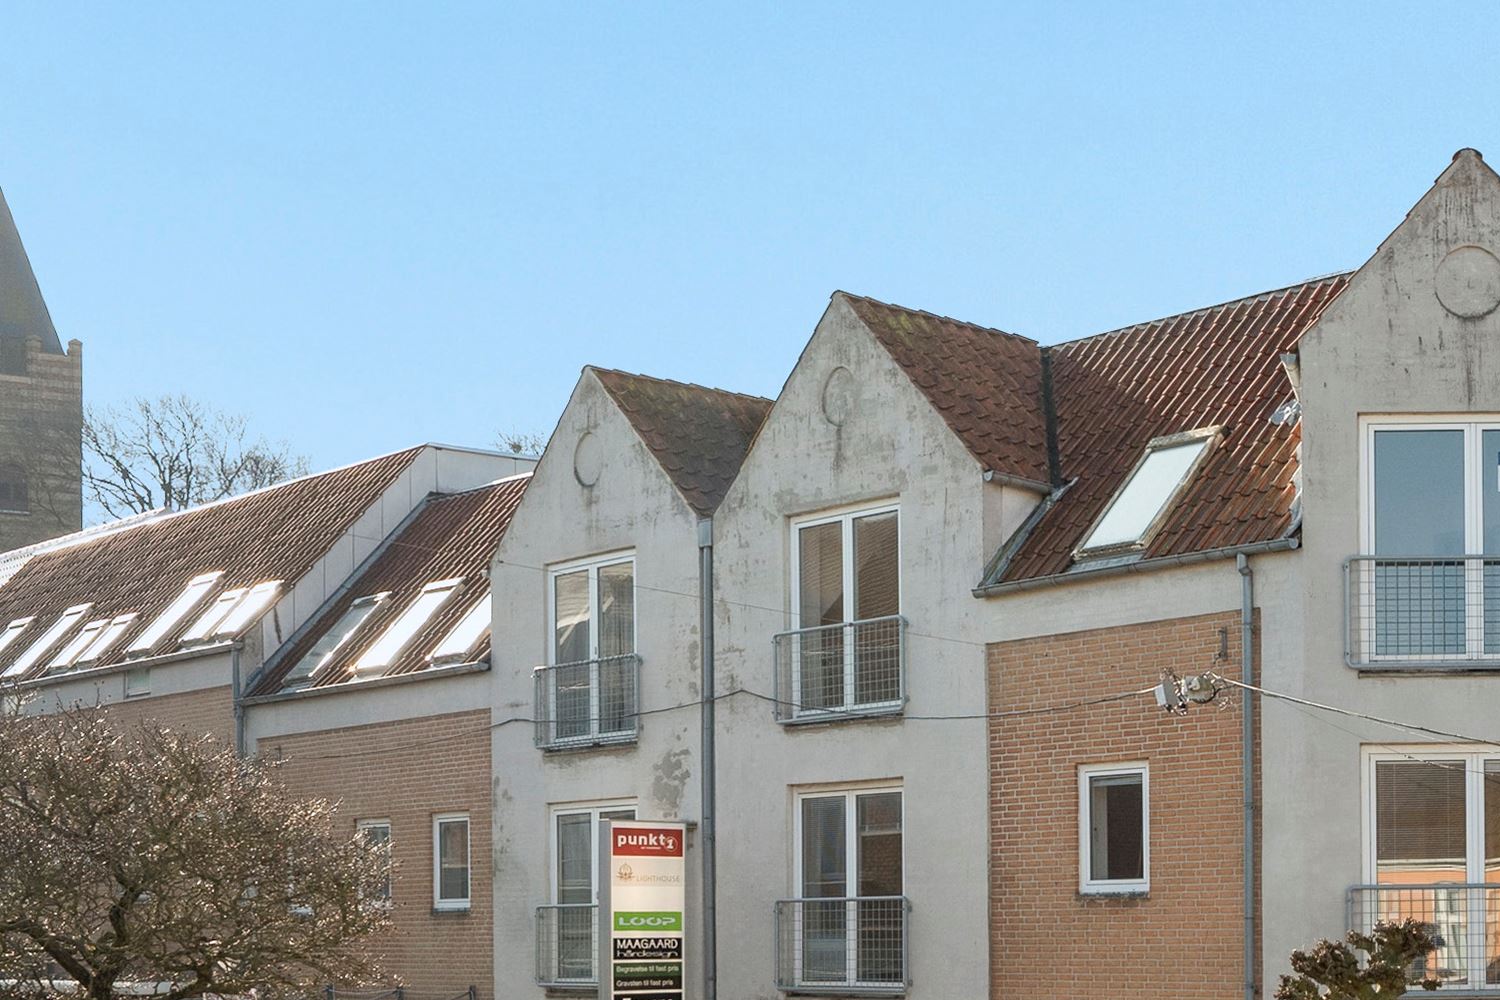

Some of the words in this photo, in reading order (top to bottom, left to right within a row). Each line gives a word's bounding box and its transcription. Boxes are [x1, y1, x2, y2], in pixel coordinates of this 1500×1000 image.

[636, 874, 681, 883] LIGHTHOUSE
[618, 916, 676, 926] LOOP
[616, 938, 678, 950] MAAGAARD
[616, 966, 648, 974] Begravelse
[616, 980, 642, 988] Gravsten
